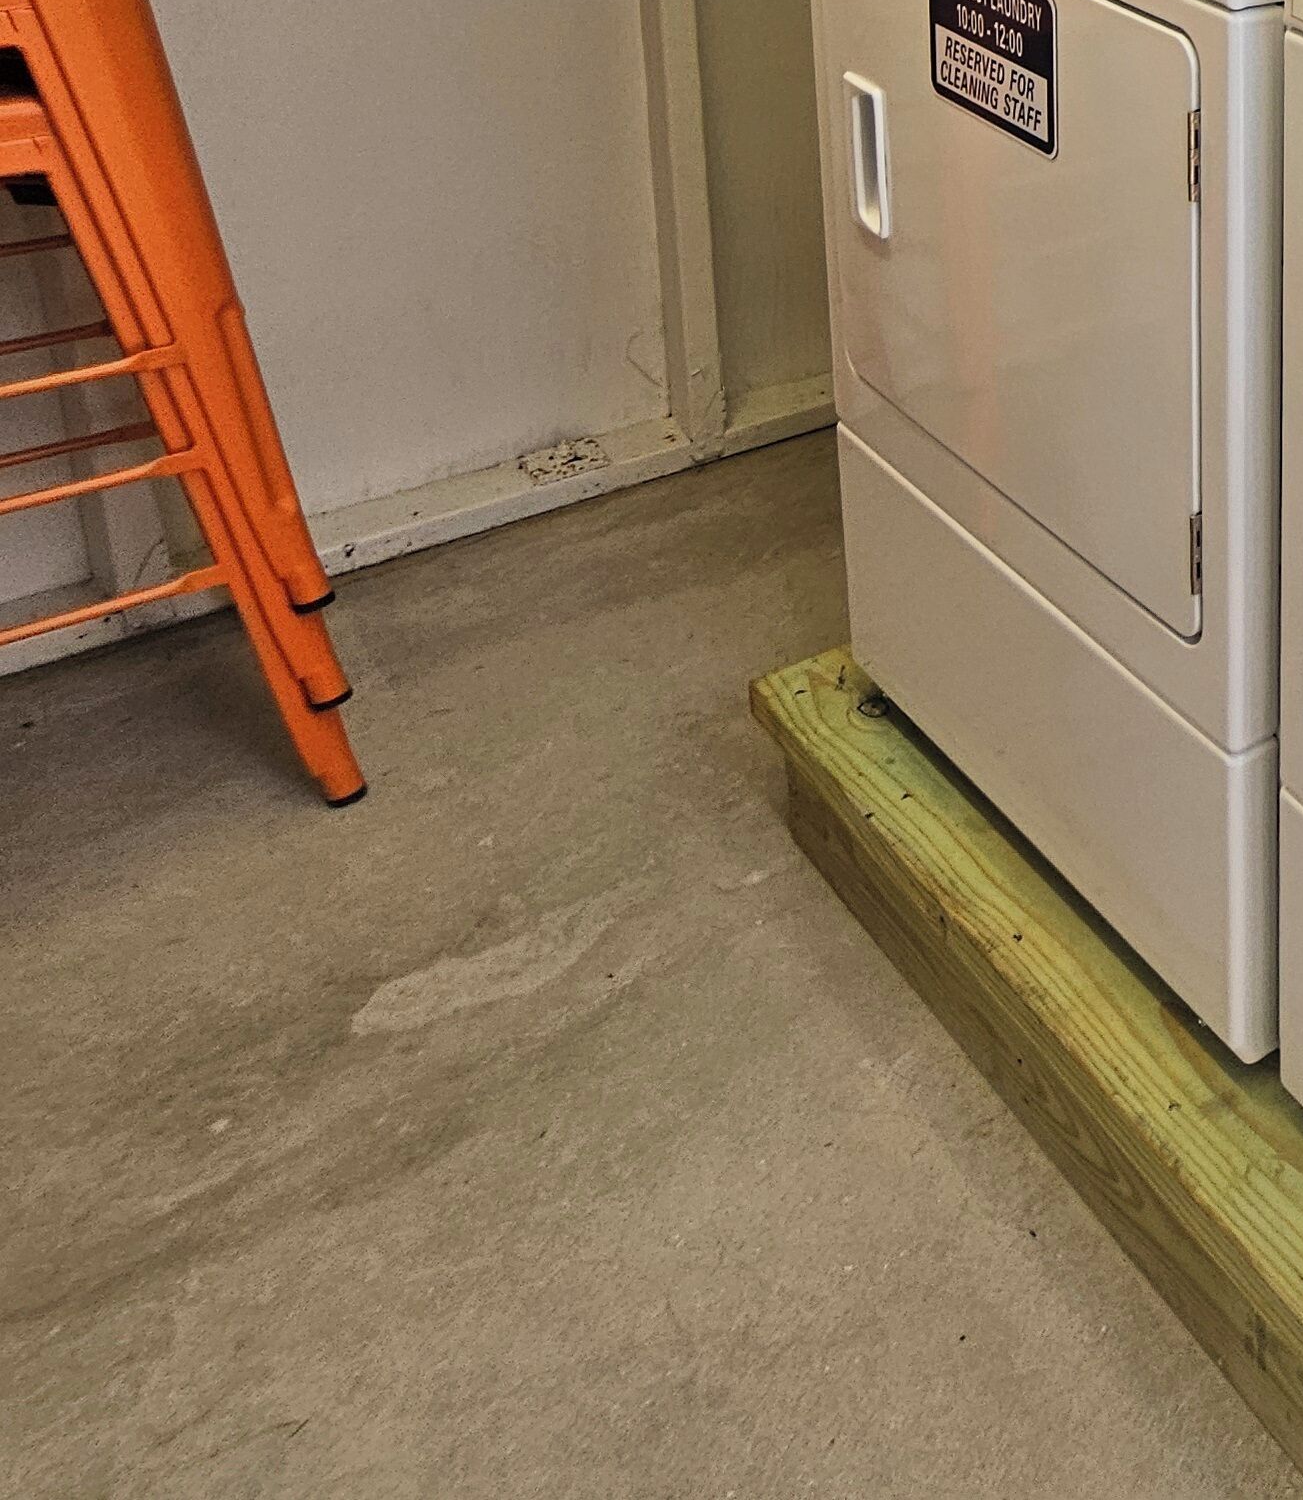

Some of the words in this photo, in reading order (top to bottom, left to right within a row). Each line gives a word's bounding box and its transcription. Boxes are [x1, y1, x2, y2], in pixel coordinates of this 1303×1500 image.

[956, 3, 984, 38] 10:00
[993, 21, 1023, 58] 12:00
[940, 60, 998, 110] CLEANING
[1003, 95, 1042, 132] STAFF
[945, 36, 1005, 85] RESERVED
[1009, 69, 1035, 102] FOR
